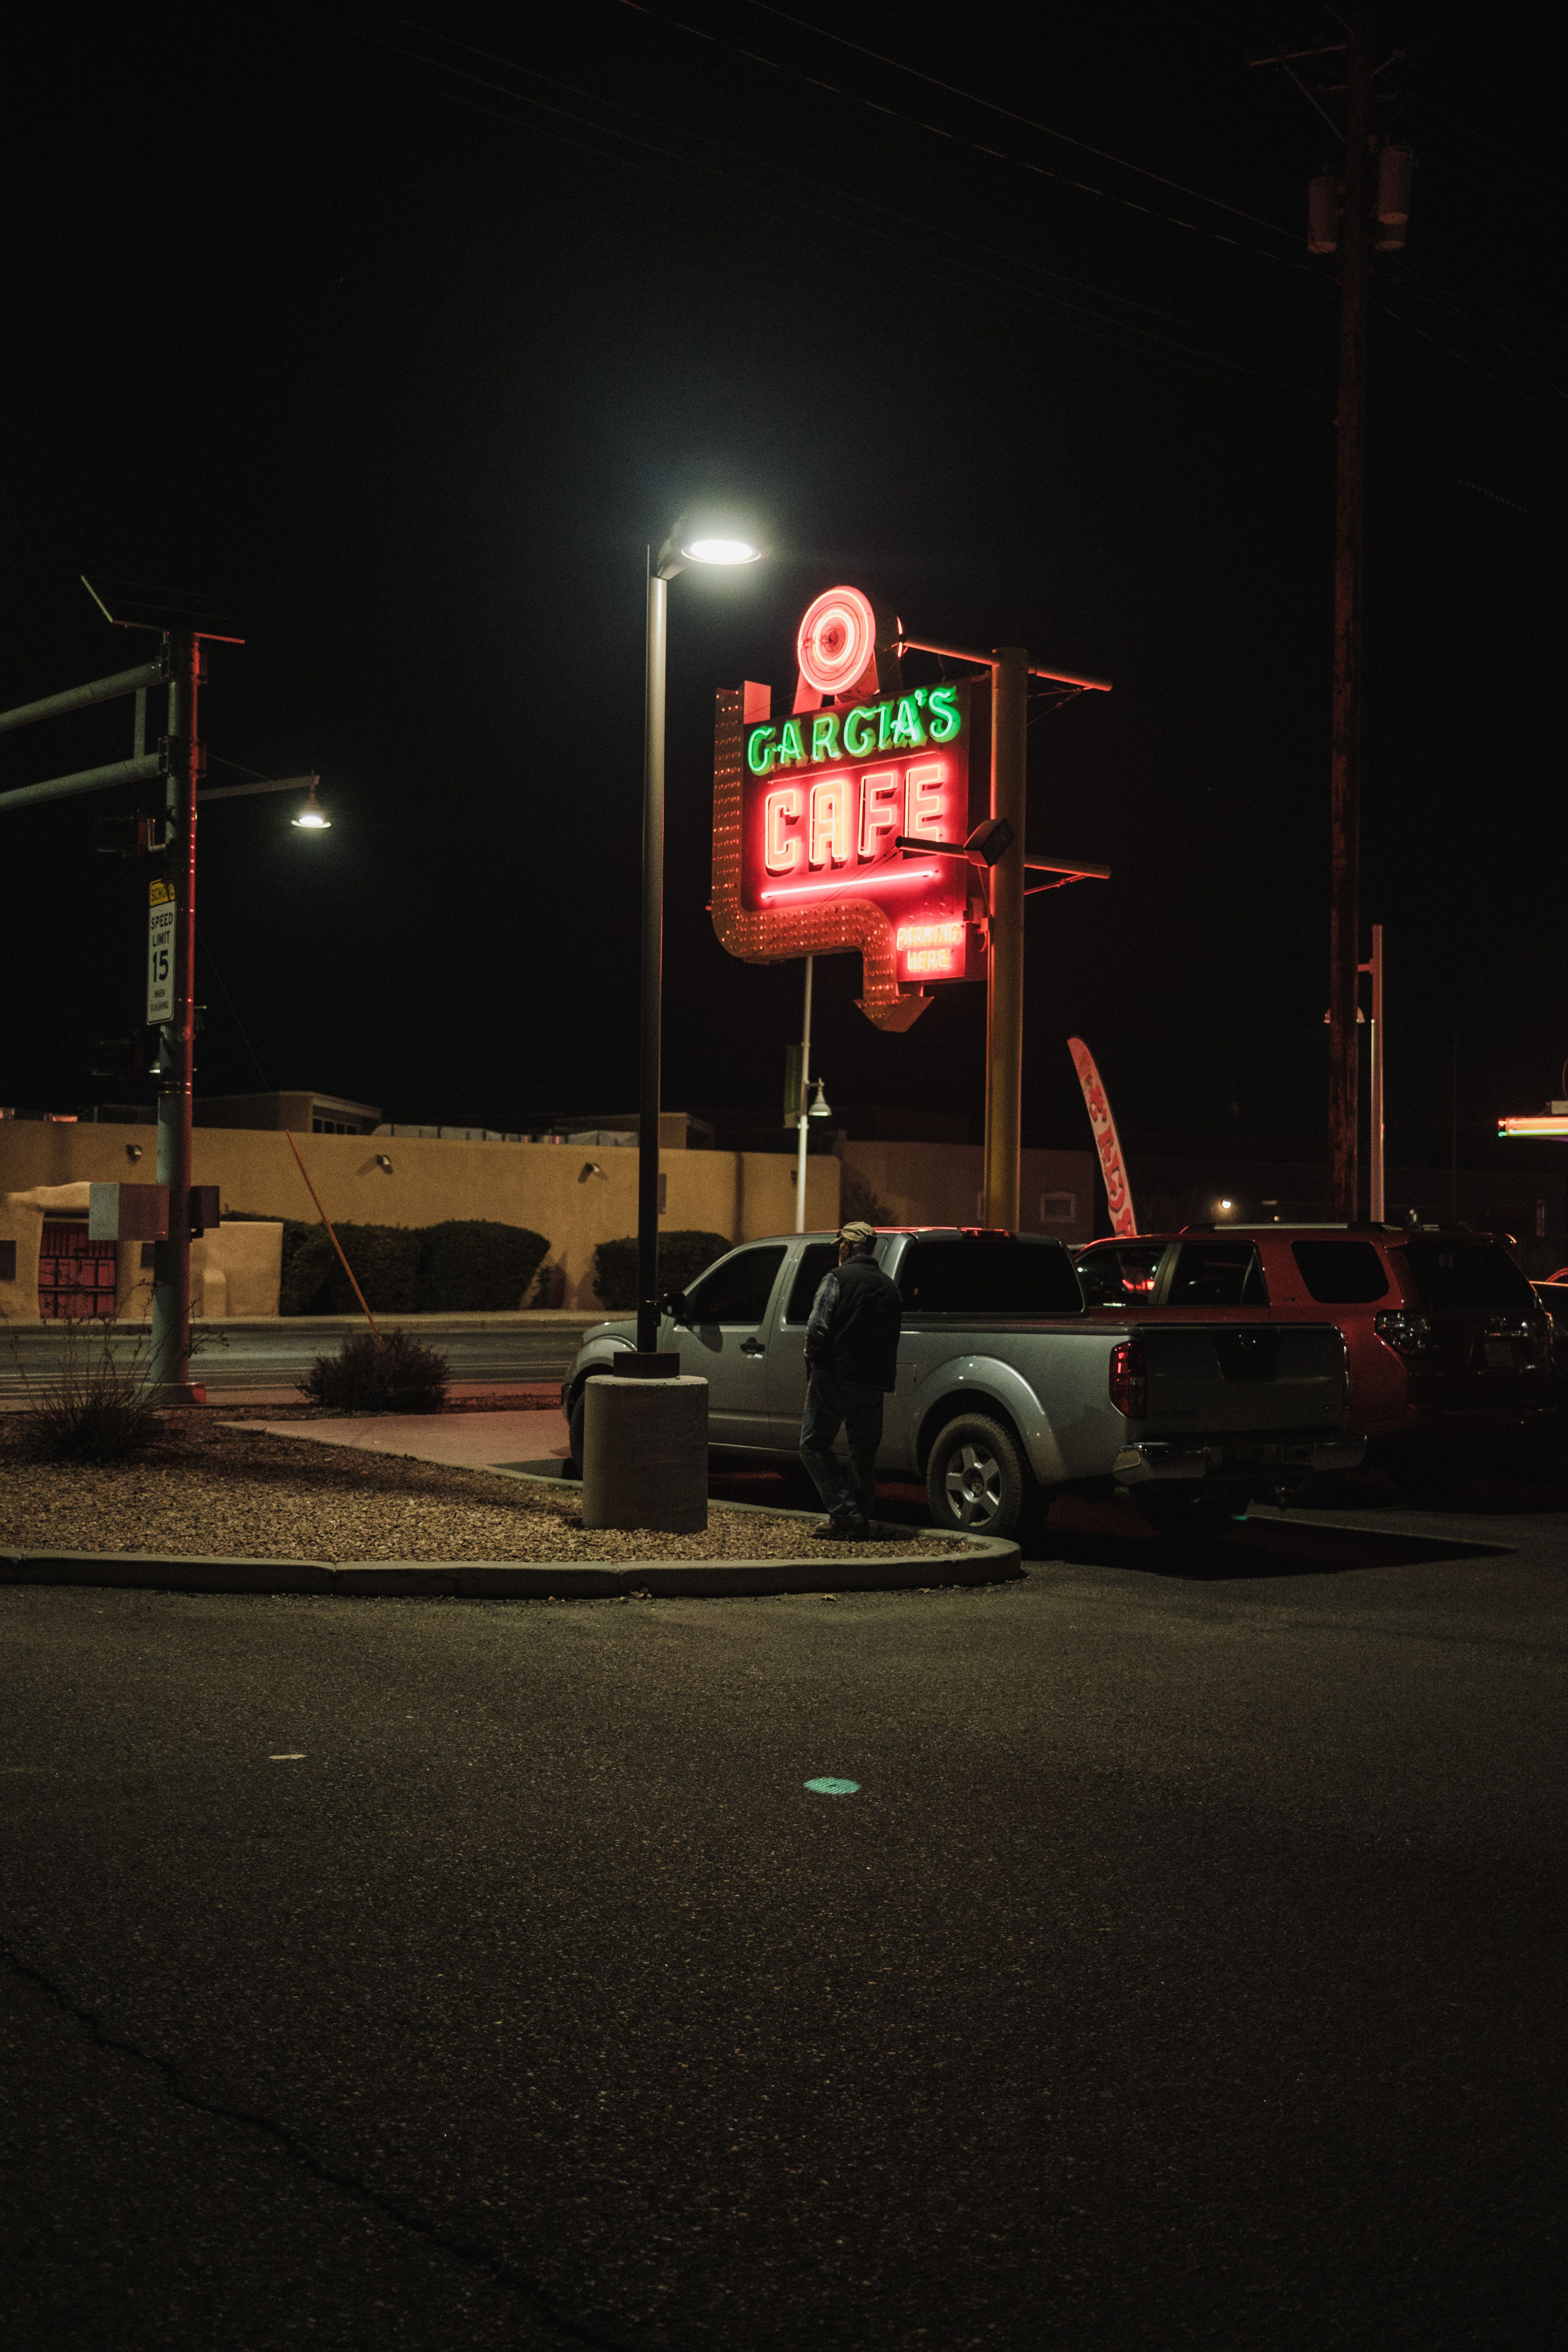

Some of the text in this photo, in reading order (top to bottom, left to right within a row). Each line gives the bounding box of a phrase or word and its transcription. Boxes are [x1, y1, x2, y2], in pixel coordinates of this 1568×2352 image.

[748, 686, 961, 776] GARCIA'S
[765, 764, 946, 872] CAFE
[152, 884, 175, 901] SCHOL
[151, 912, 173, 930] SPEED
[152, 931, 170, 947] LIMIT
[897, 922, 963, 947] PARKING
[153, 949, 169, 982] 15
[907, 949, 951, 972] HERE
